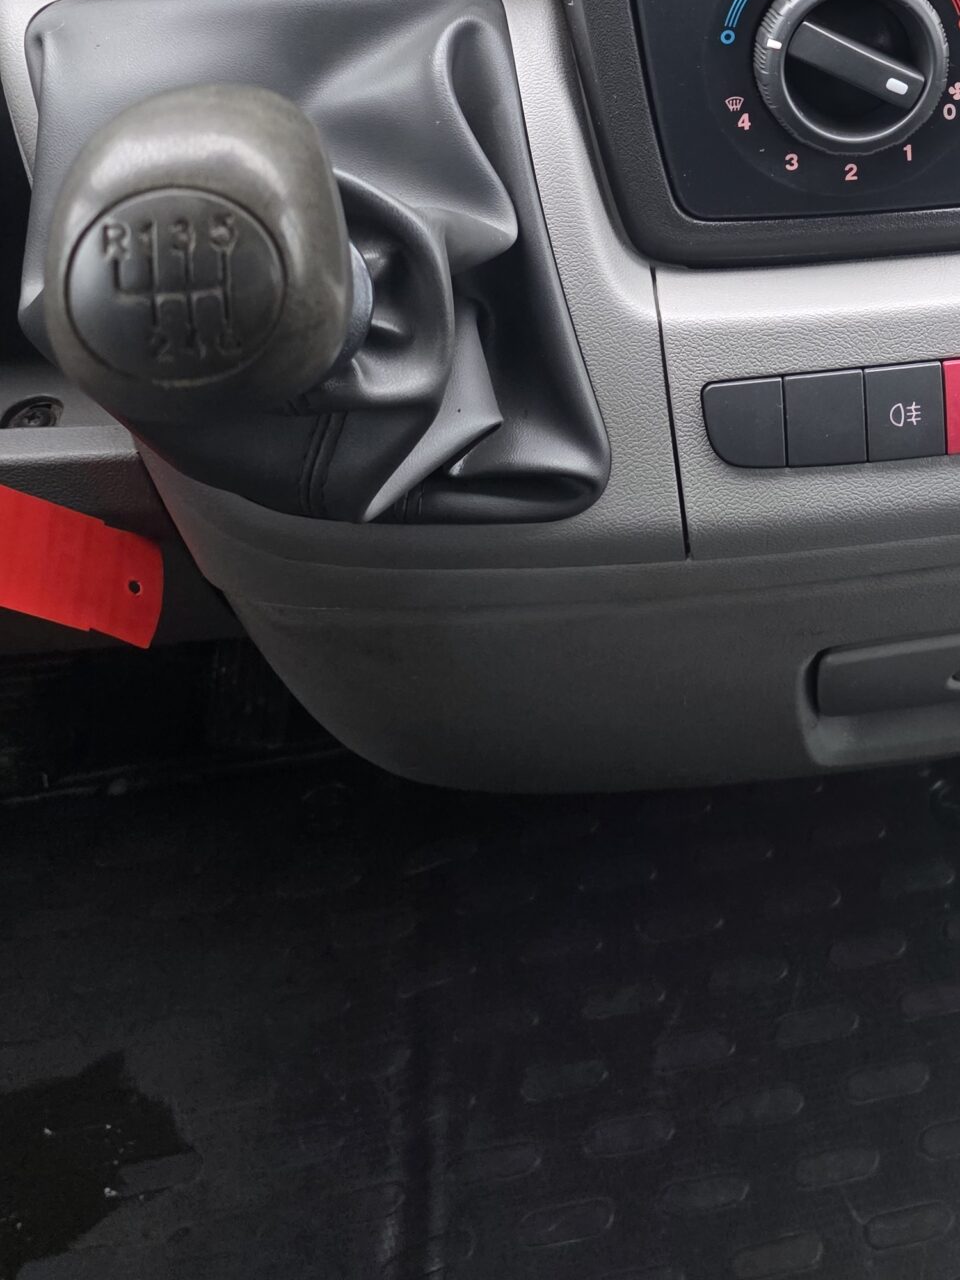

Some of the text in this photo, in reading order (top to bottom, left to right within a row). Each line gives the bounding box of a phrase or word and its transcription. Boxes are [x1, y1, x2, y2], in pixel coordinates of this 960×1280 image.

[943, 104, 956, 120] 0
[737, 113, 751, 130] 4
[903, 144, 913, 161] 1
[785, 153, 799, 171] 3
[844, 163, 858, 181] 2
[102, 224, 127, 255] R
